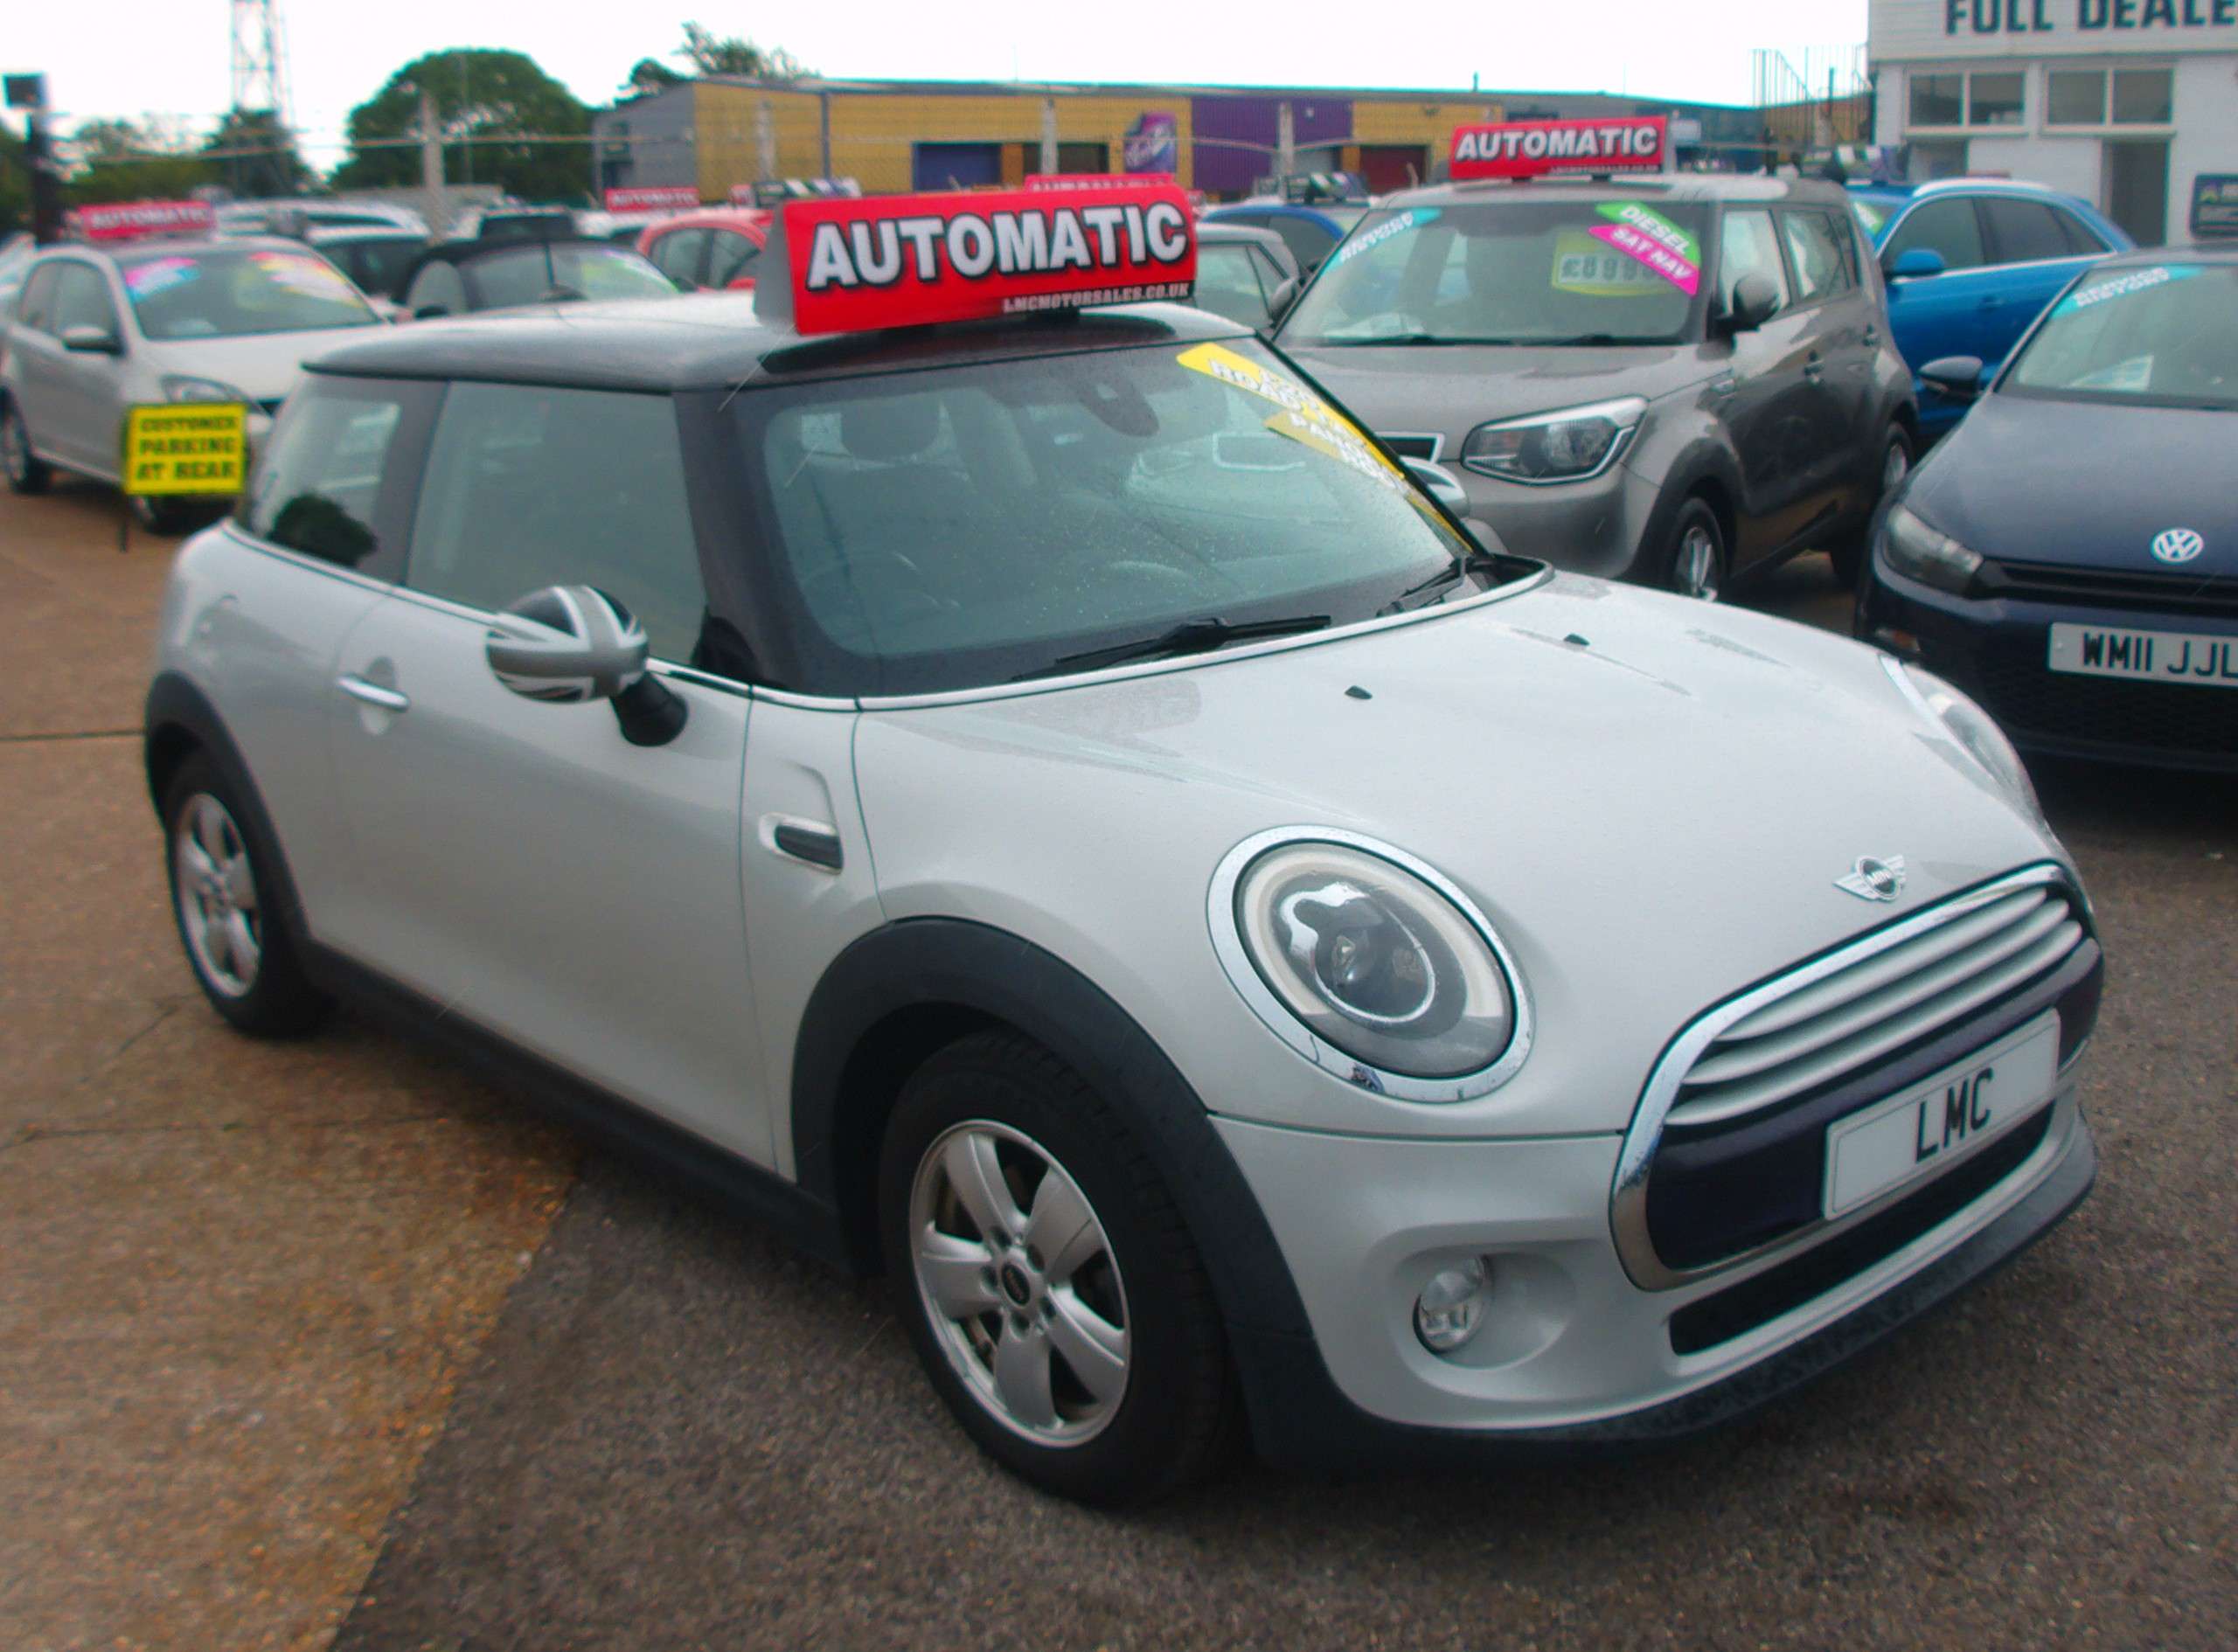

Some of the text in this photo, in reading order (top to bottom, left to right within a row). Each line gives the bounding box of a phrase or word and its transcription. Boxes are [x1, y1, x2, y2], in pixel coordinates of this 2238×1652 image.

[1946, 0, 2054, 35] FULL
[1456, 126, 1658, 160] AUTOMATIC
[808, 202, 1188, 292] AUTOMATIC
[1620, 205, 1690, 254] DIESEL
[1610, 227, 1694, 280] SAT NAV
[1002, 282, 1190, 314] LMCMOTORSALES.CO.UK
[139, 417, 237, 433] CUSTOMER
[138, 438, 237, 456] PARKING
[136, 462, 237, 481] AT REAR
[2082, 632, 2238, 679] WM11 JJL
[1915, 1067, 1993, 1163] LMC
